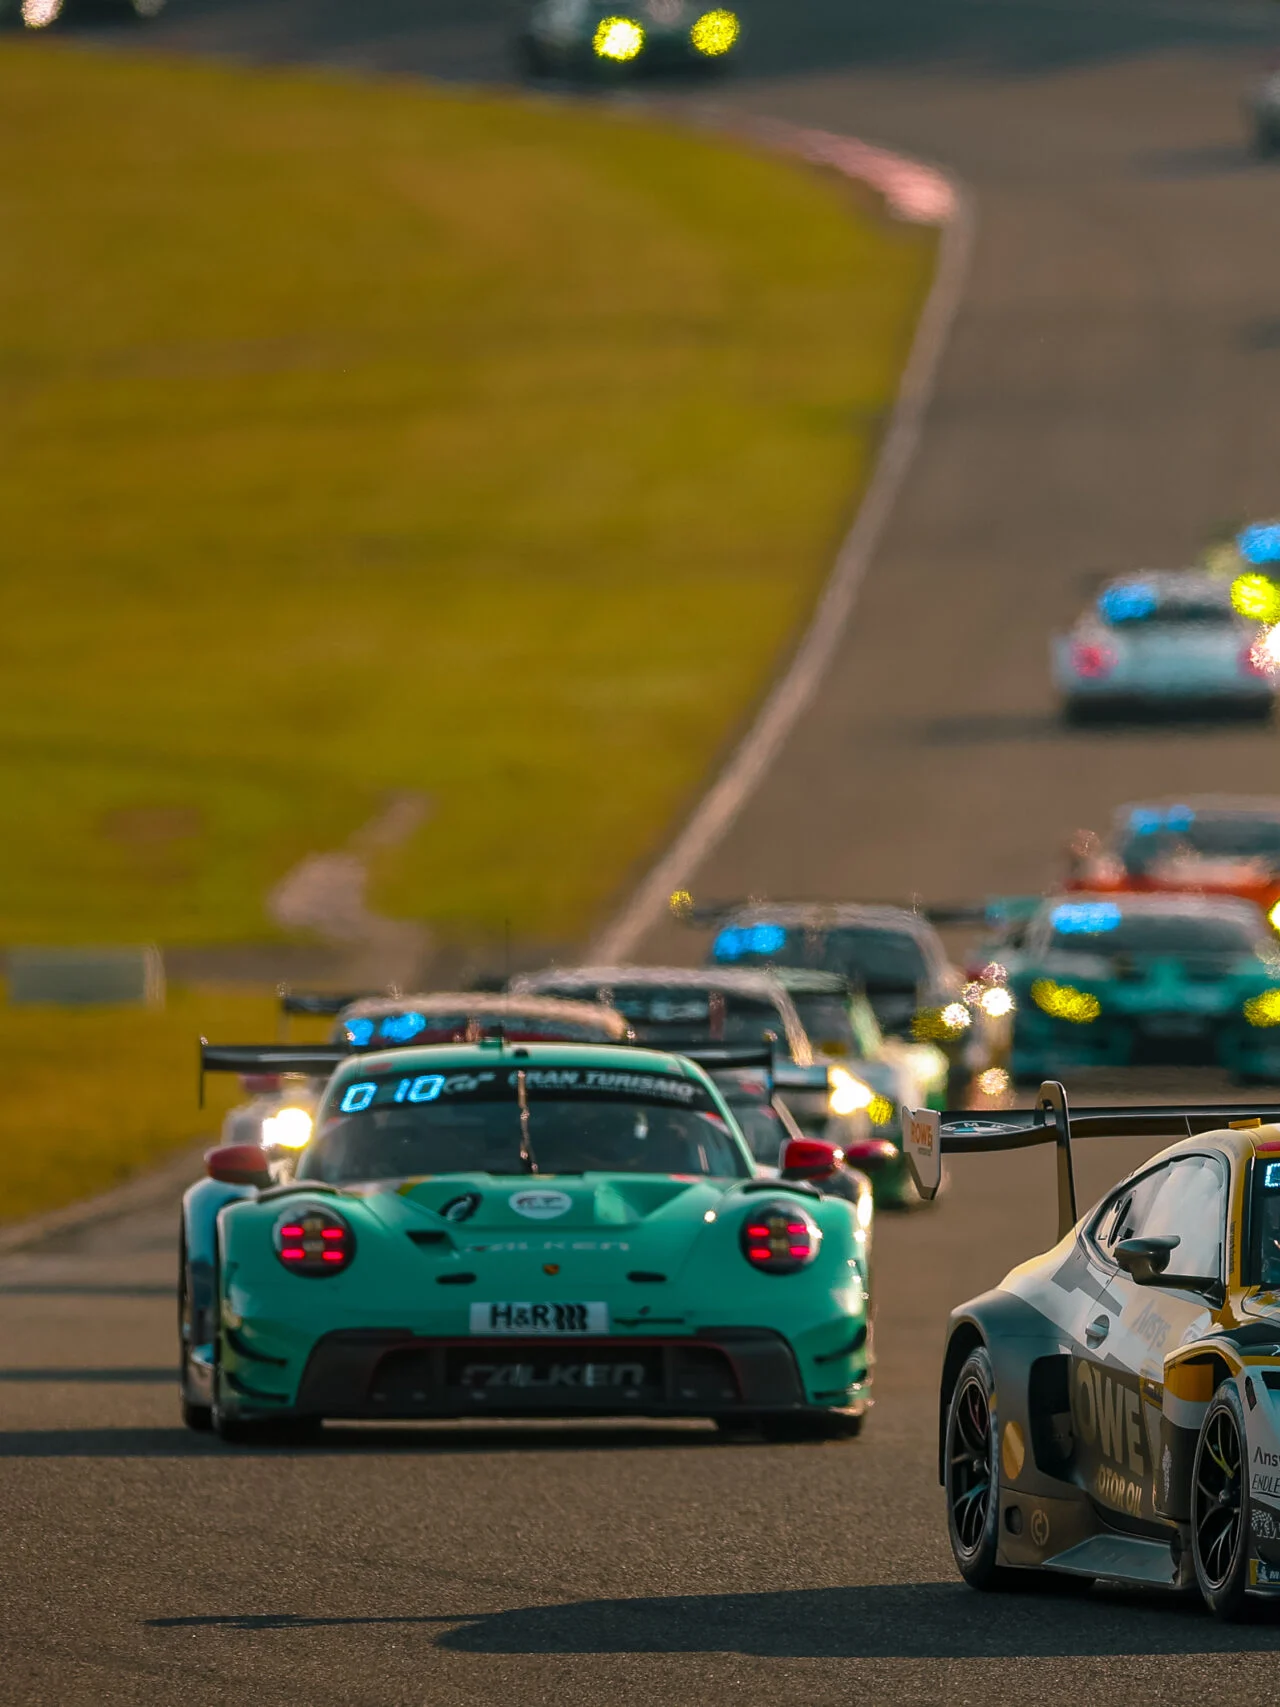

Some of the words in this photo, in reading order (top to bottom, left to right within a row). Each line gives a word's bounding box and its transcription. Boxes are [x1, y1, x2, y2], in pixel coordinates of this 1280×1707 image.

[508, 1070, 580, 1087] GRAN
[585, 1071, 694, 1098] TURISMO
[490, 1303, 549, 1329] H&R
[1076, 1359, 1145, 1477] OWE
